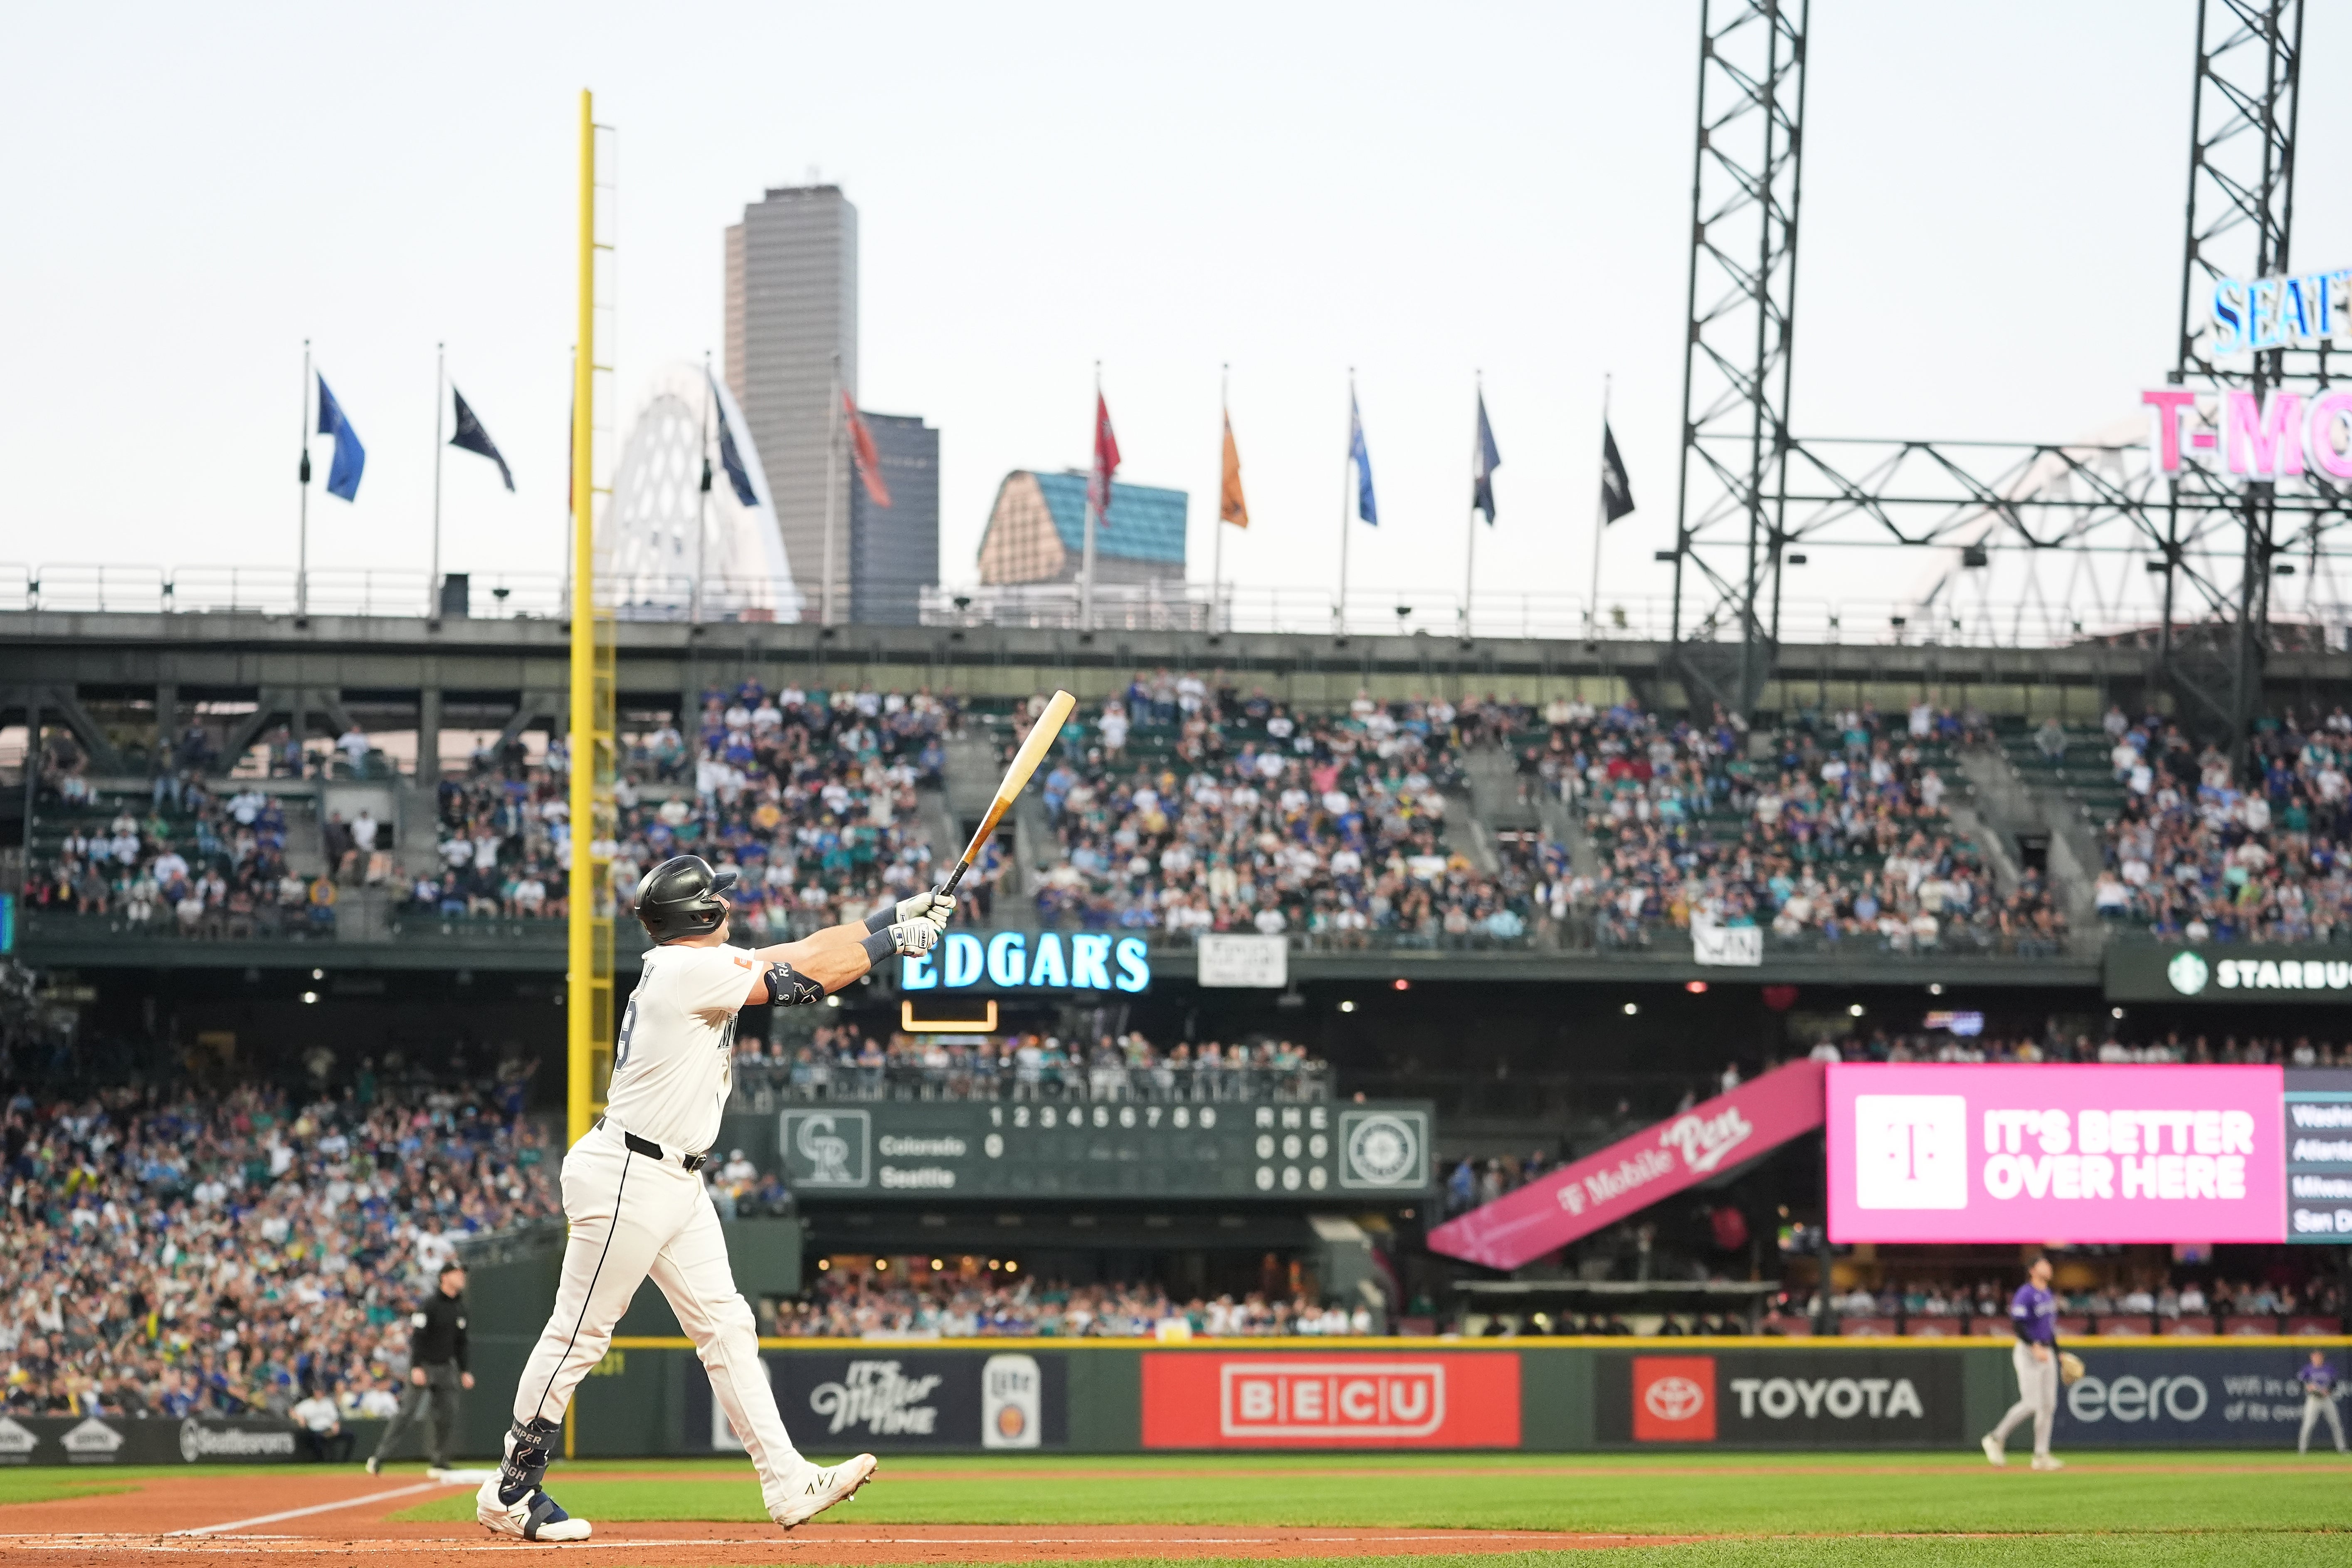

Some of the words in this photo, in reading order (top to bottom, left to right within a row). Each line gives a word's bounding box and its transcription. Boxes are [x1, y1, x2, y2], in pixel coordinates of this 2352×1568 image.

[2216, 959, 2352, 989] STARBU
[990, 1107, 1002, 1126] 1
[1014, 1106, 1030, 1127] 2
[1041, 1106, 1056, 1128] 3
[1067, 1107, 1082, 1127] 4
[1146, 1106, 1162, 1127] 7
[1310, 1107, 1327, 1129] E
[1983, 1109, 2072, 1155] IT'S
[2077, 1109, 2255, 1155] BETTER
[879, 1135, 966, 1156] Colorado
[984, 1134, 1003, 1158] 0
[1256, 1134, 1275, 1159] 0
[1283, 1134, 1302, 1159] 0
[1309, 1134, 1328, 1159] 0
[879, 1166, 955, 1189] Seattle
[1255, 1166, 1274, 1191] 0
[1282, 1166, 1301, 1191] 0
[1583, 1149, 1676, 1206] Mobile
[1983, 1154, 2115, 1201] OVER
[2121, 1154, 2246, 1200] HERE
[2293, 1208, 2333, 1233] San
[1240, 1379, 1427, 1420] BECU
[1730, 1378, 1923, 1418] TOYOTA
[2067, 1375, 2208, 1423] eero
